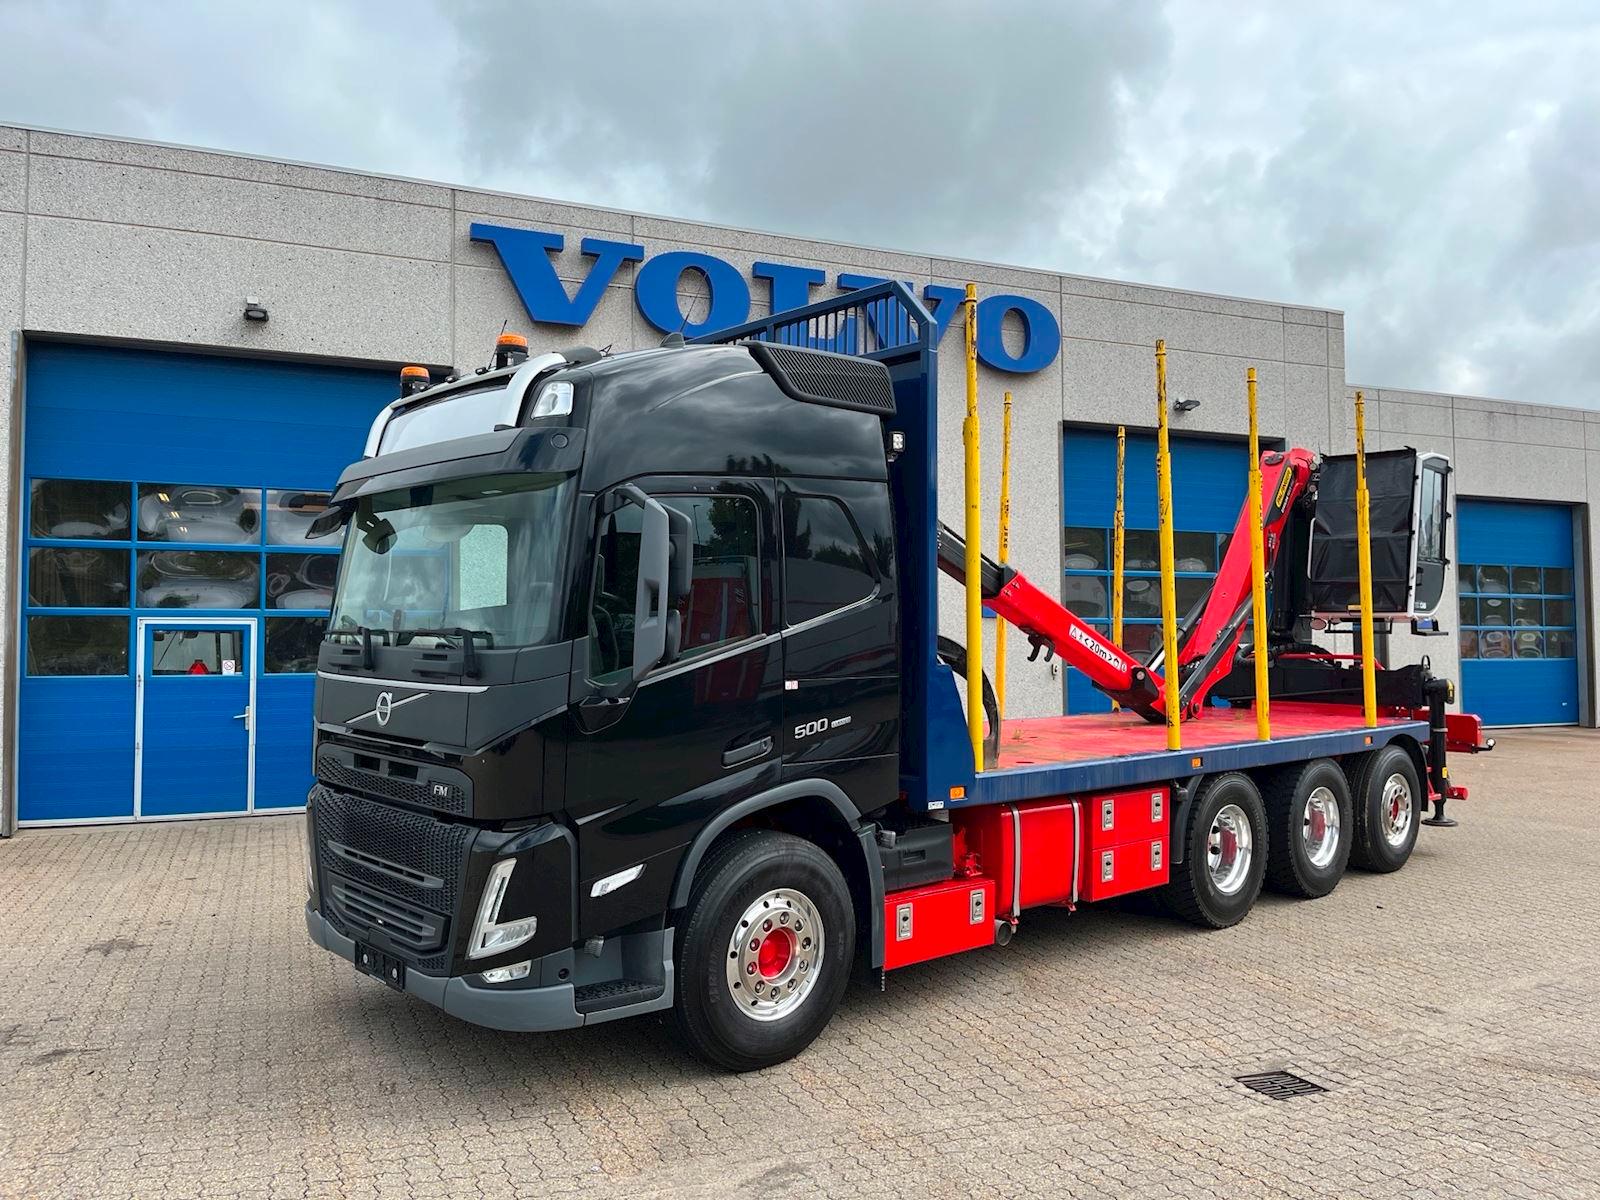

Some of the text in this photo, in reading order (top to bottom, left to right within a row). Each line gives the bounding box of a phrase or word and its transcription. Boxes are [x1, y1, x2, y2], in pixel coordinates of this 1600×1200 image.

[470, 222, 1060, 374] VOLVO
[794, 718, 829, 739] 500
[433, 784, 448, 797] FM
